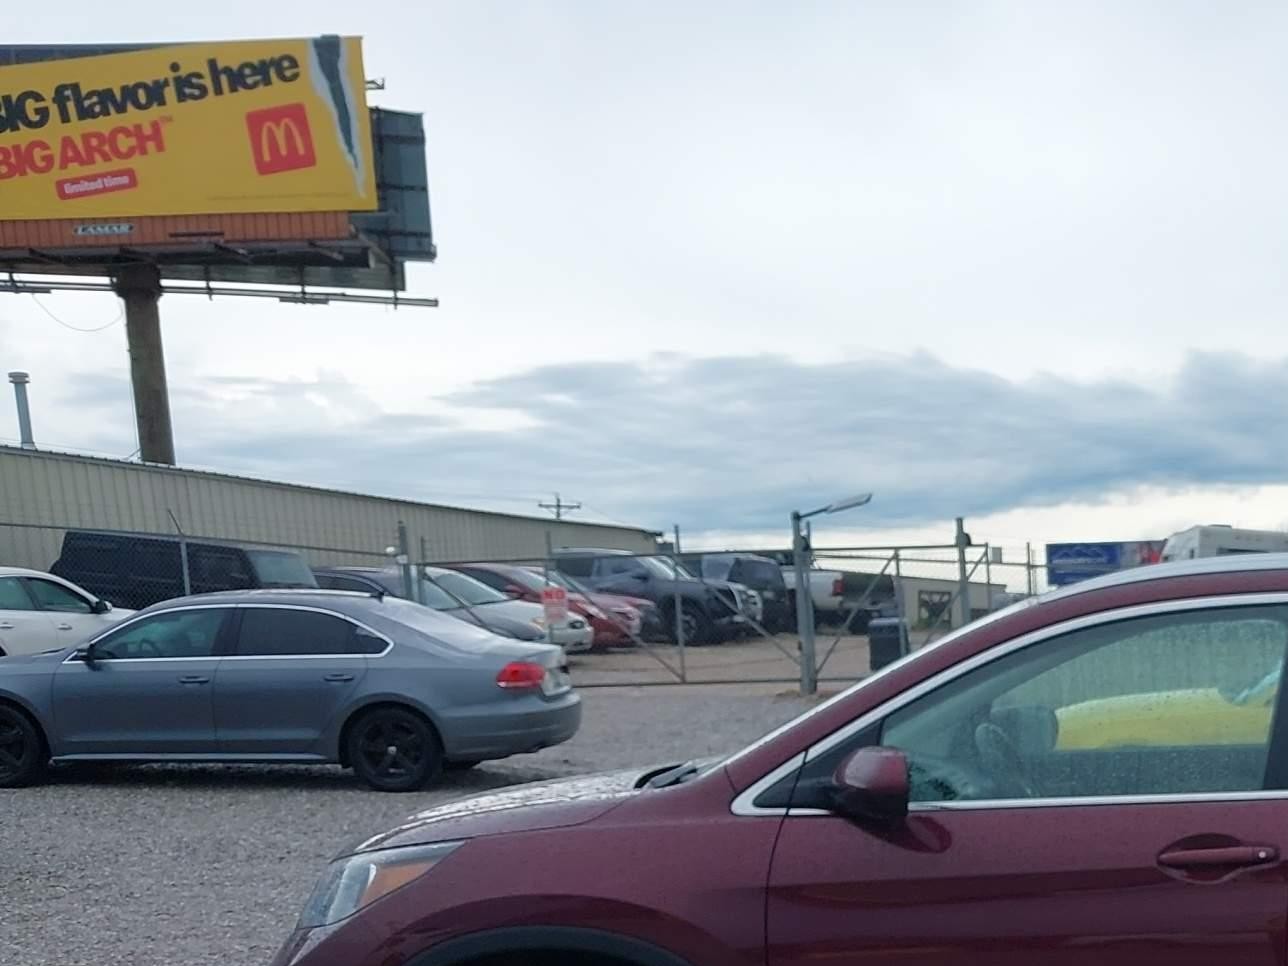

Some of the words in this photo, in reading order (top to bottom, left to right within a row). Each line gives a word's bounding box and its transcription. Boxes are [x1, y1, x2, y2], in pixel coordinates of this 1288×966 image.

[52, 82, 168, 124] flavor
[169, 61, 208, 103] is
[207, 54, 300, 97] here
